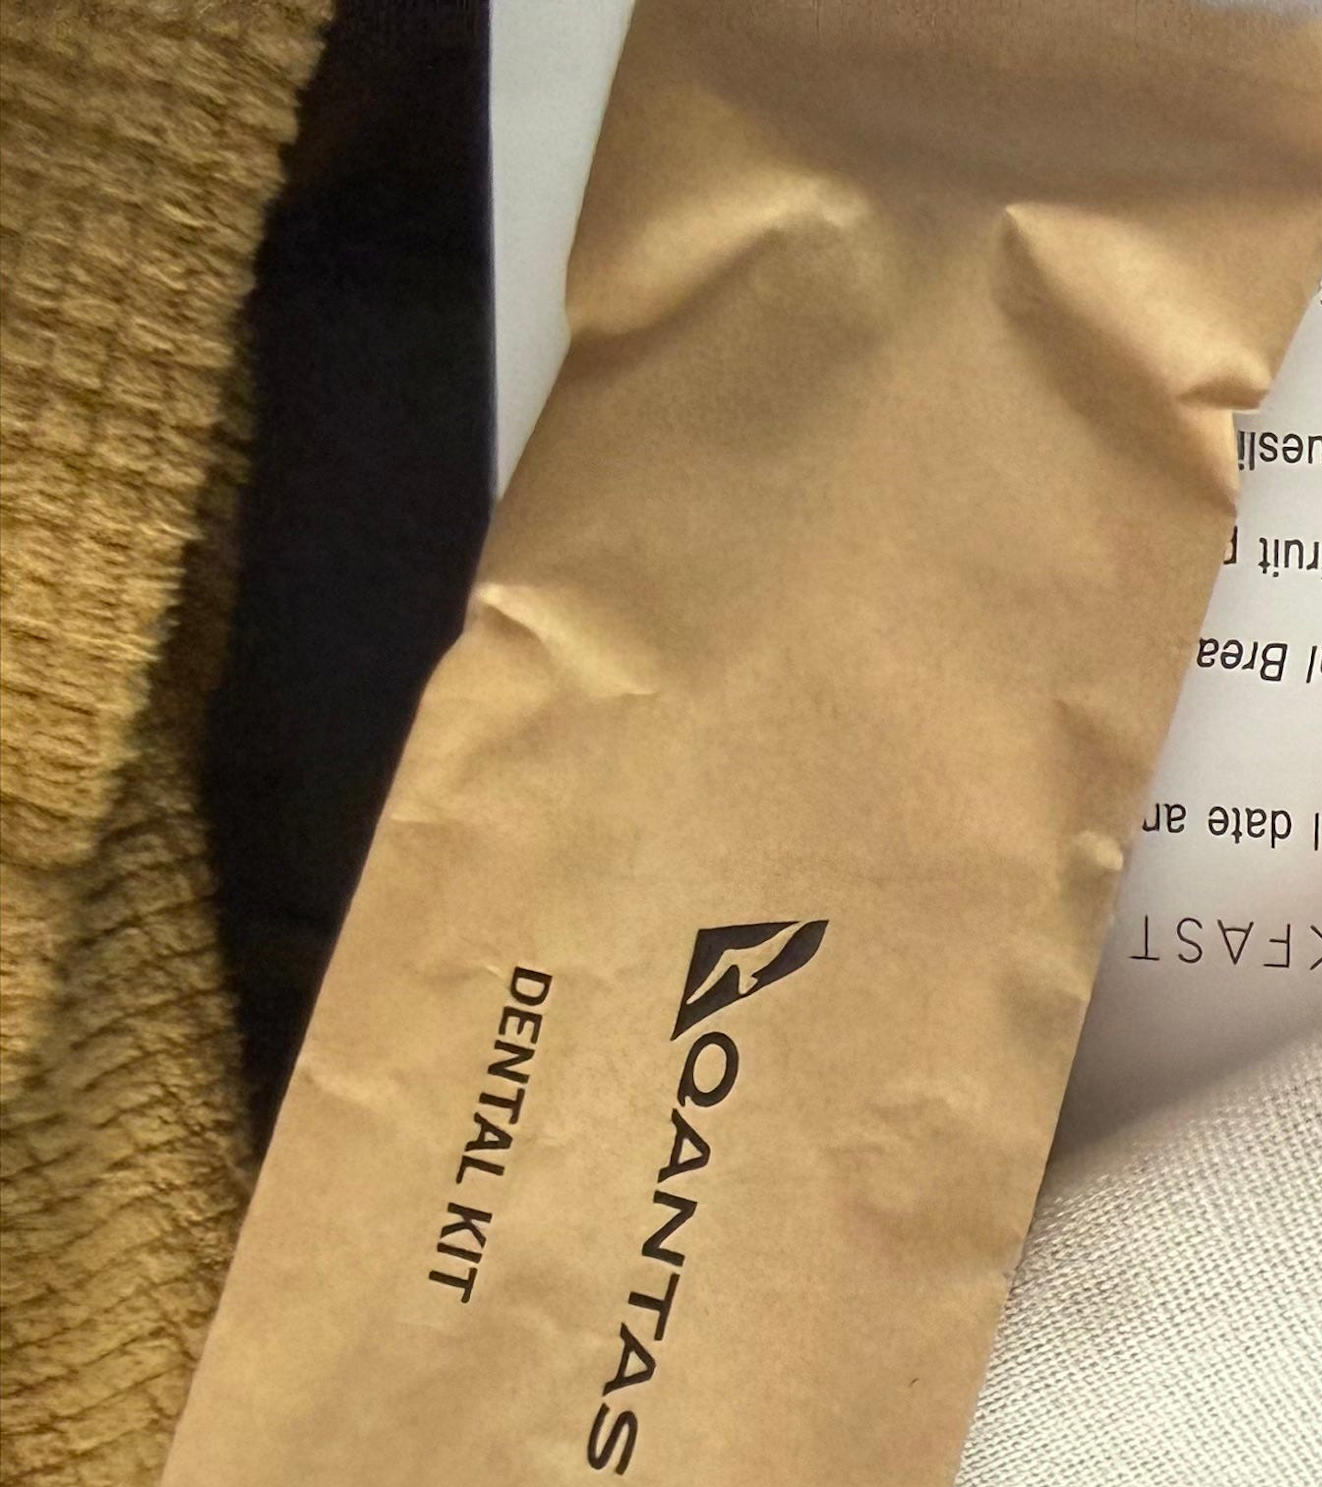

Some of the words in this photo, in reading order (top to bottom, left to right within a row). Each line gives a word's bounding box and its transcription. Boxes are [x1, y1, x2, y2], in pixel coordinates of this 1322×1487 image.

[1196, 639, 1288, 682] Brea
[1208, 806, 1292, 849] date
[456, 966, 554, 1185] DENTAL
[428, 1202, 494, 1304] KIT
[587, 1031, 740, 1476] QANTAS
